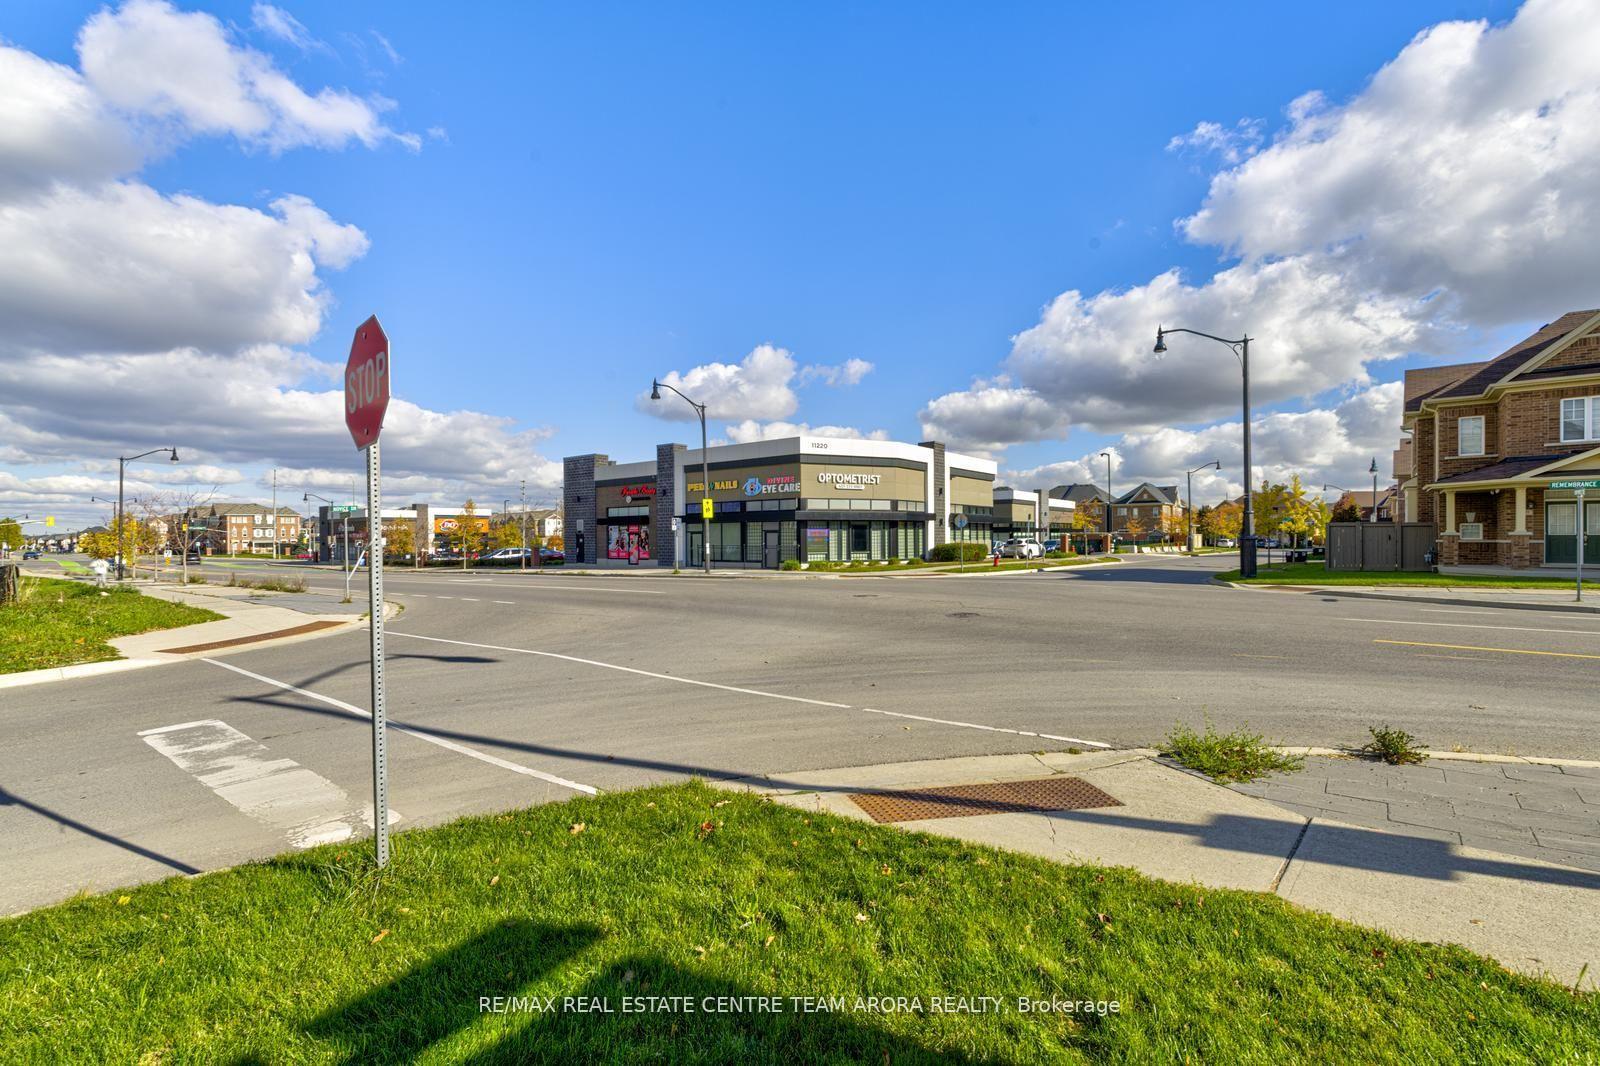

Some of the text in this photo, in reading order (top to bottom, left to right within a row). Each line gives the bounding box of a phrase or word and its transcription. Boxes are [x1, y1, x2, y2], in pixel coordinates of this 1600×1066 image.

[348, 351, 386, 414] STOP
[767, 475, 795, 485] DIVINE
[818, 472, 881, 484] OPTOMETRIST
[714, 480, 738, 490] NAILS
[762, 483, 801, 494] EYE CARE
